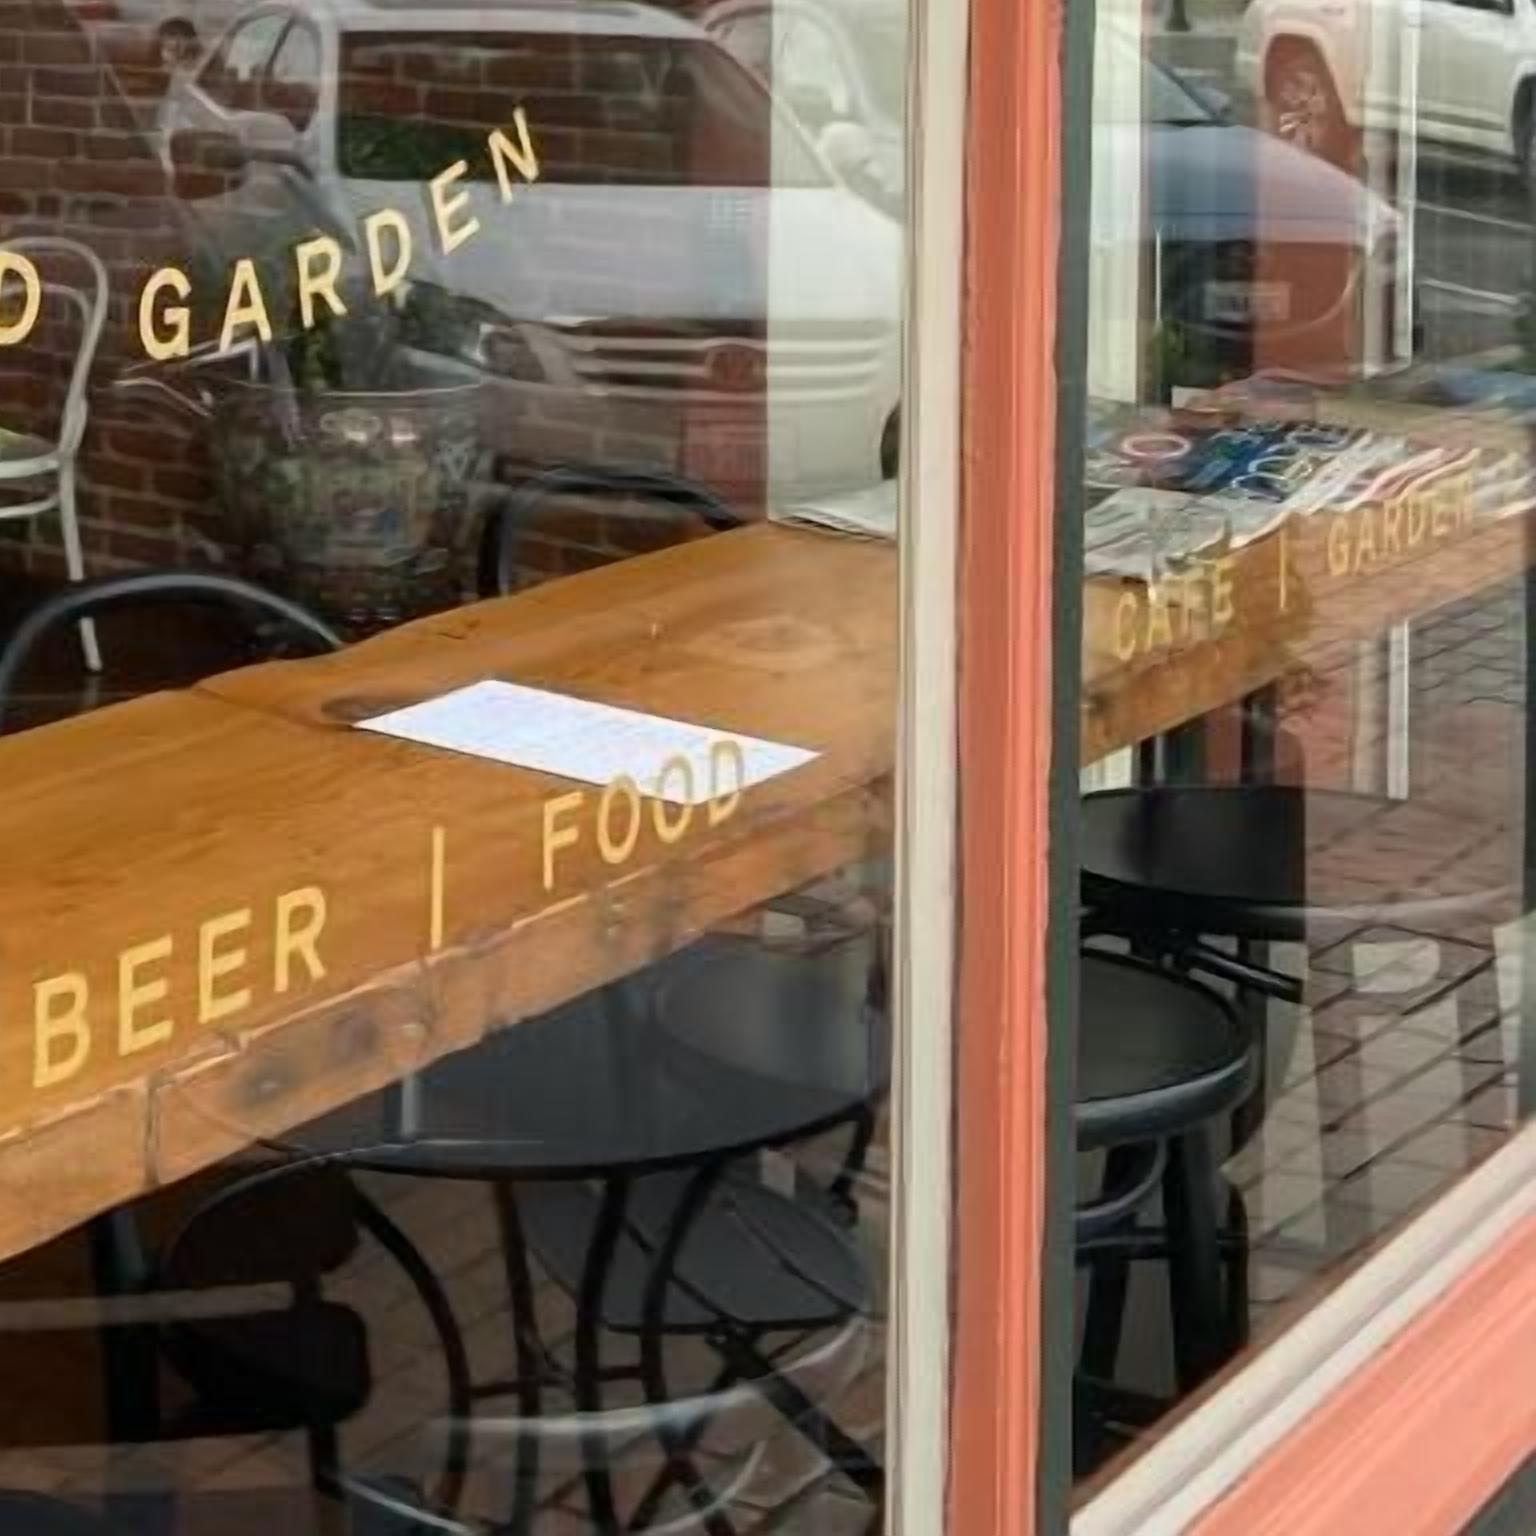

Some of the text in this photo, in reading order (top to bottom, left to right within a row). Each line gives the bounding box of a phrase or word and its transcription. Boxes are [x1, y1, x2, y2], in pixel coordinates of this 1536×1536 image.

[138, 107, 540, 360] GARDEN
[30, 885, 330, 1088] BEER
[542, 739, 745, 892] FOOD
